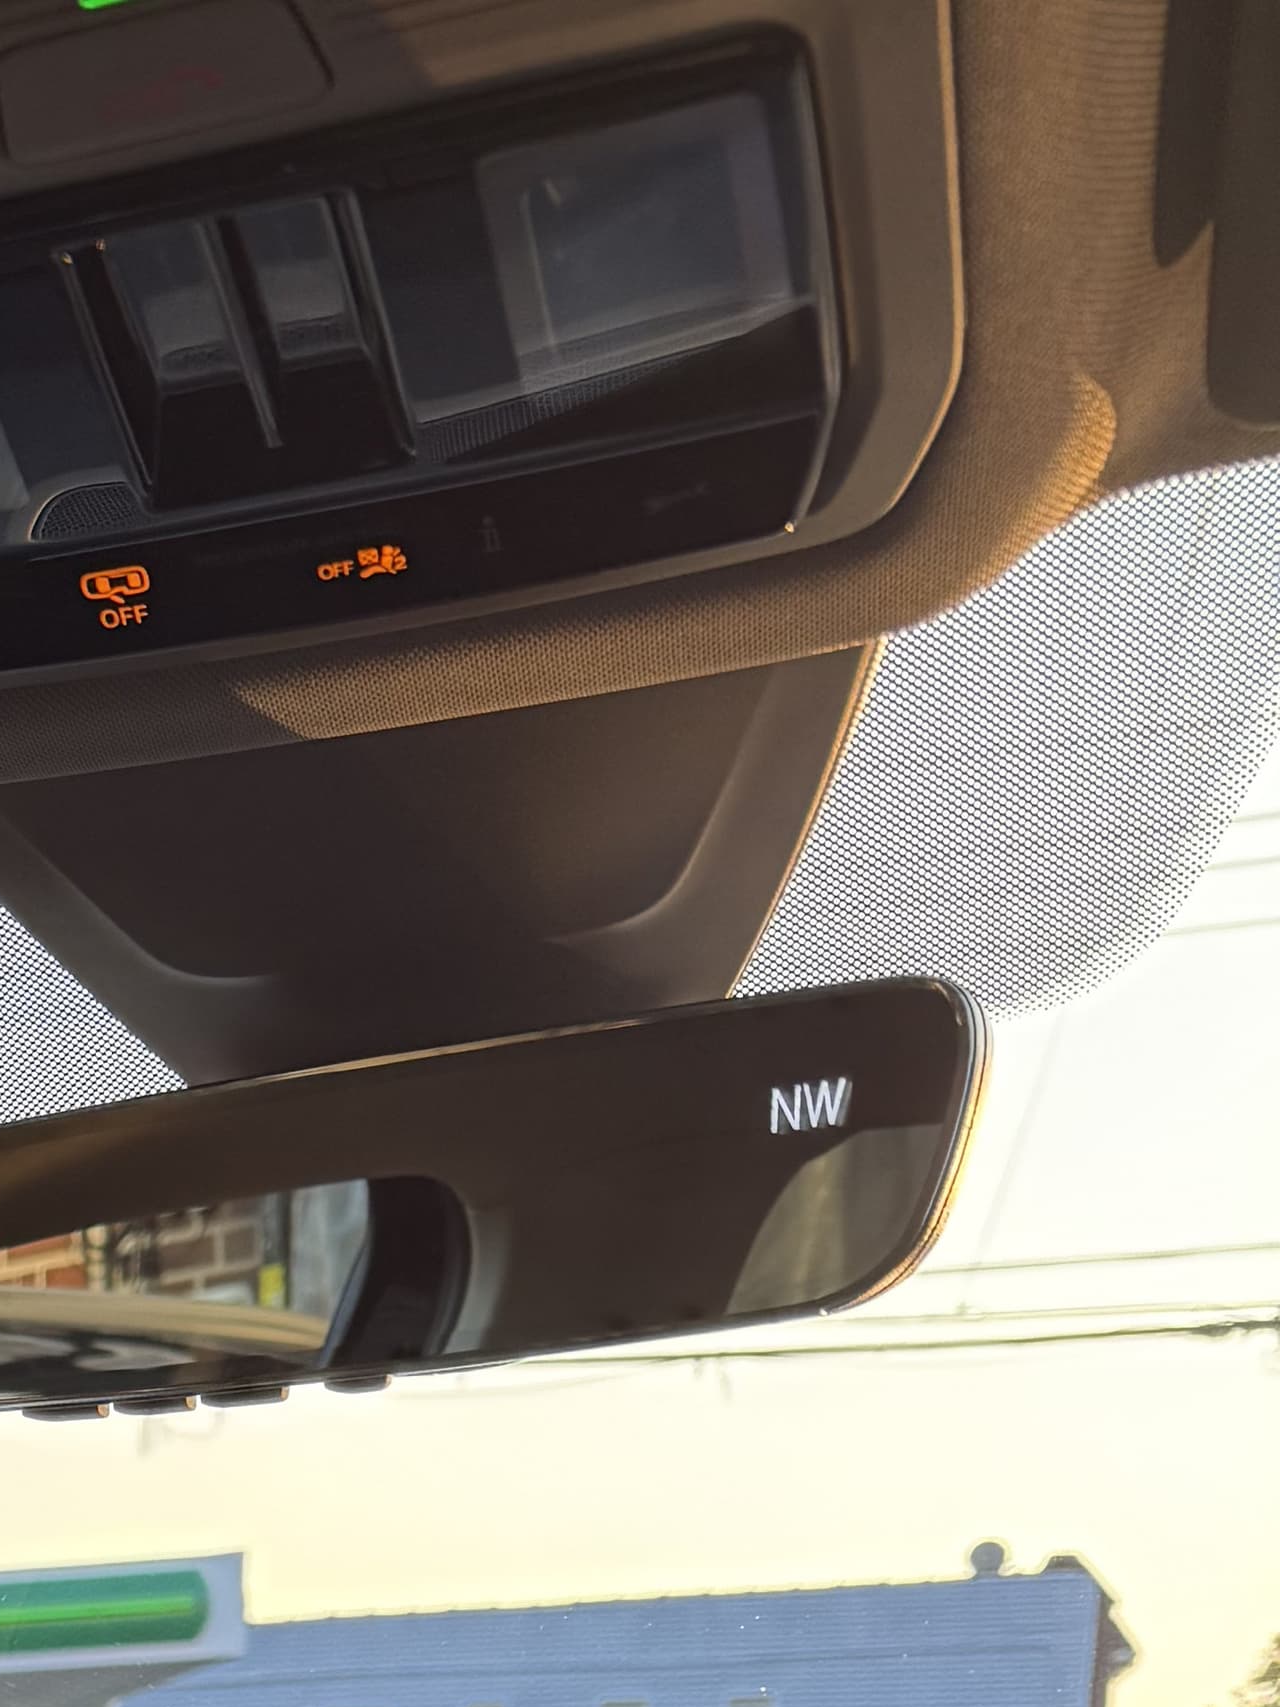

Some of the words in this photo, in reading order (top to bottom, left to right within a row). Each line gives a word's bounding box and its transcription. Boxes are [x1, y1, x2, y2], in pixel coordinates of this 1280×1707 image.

[316, 560, 354, 581] OFF
[99, 604, 148, 629] OFF
[770, 1077, 848, 1134] NW
